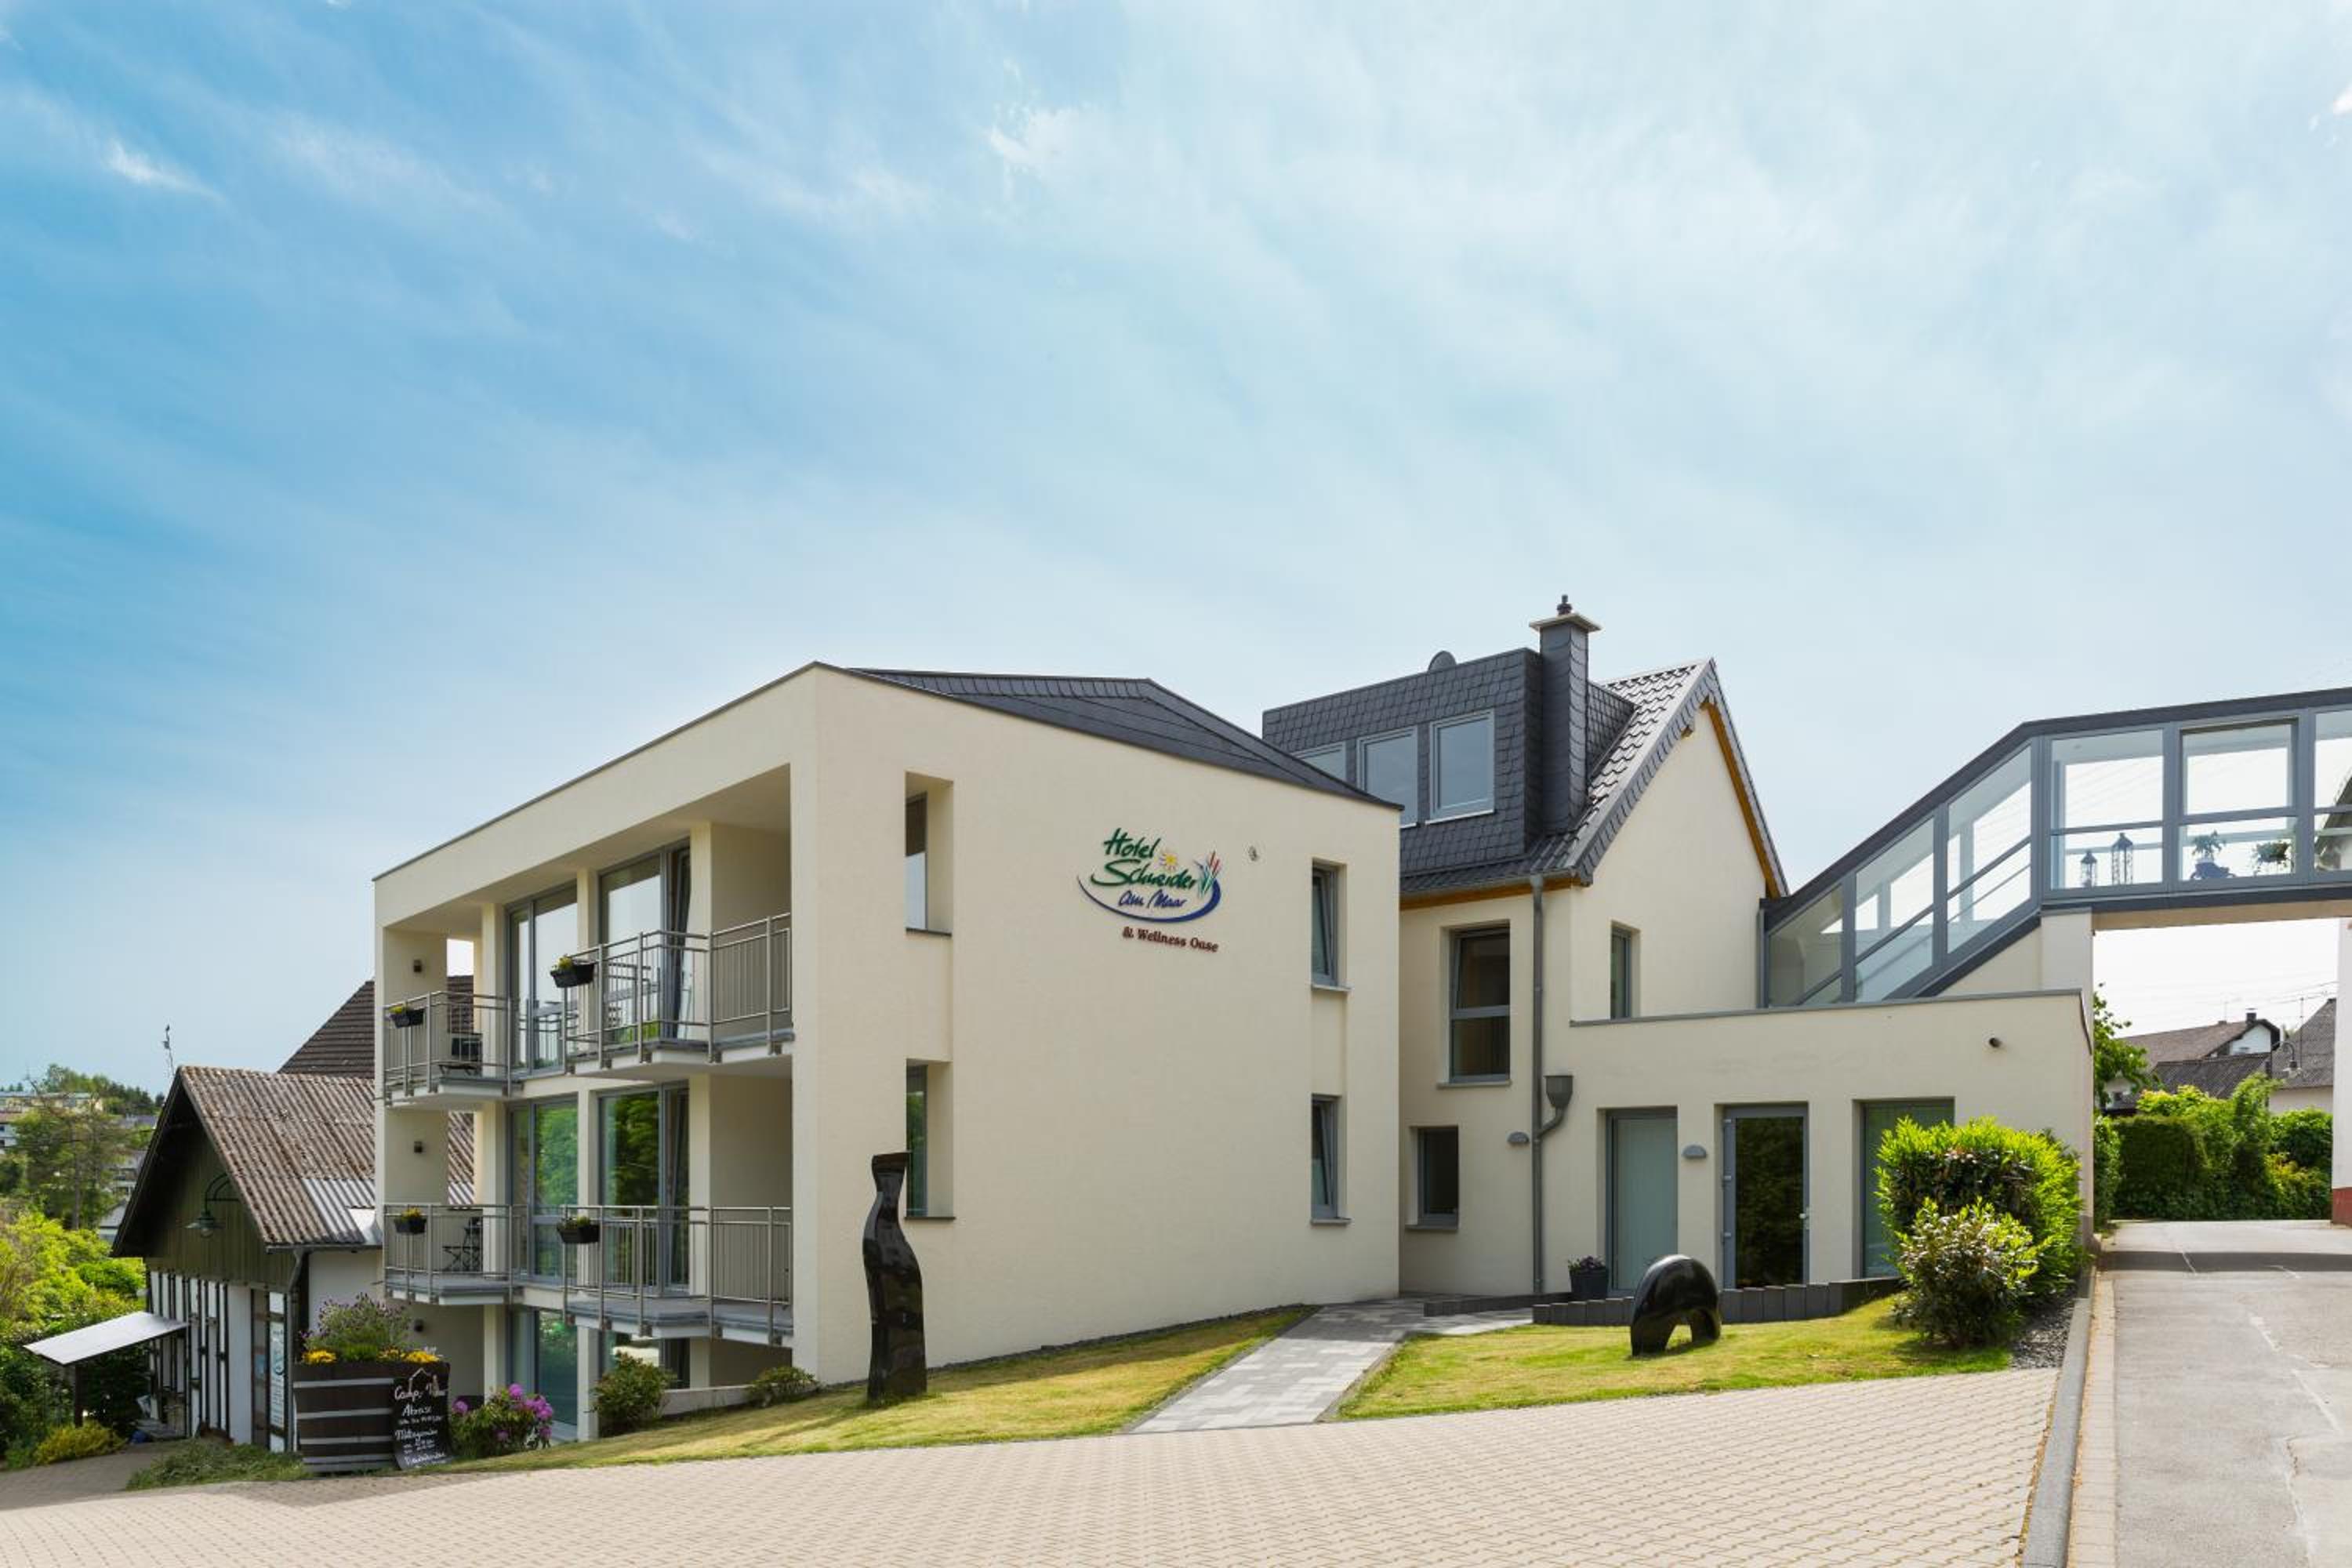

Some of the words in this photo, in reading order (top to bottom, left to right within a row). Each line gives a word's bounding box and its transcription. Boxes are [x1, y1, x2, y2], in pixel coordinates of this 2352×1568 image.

[1103, 828, 1160, 858] Hotel
[1091, 859, 1196, 889] Schneider
[1122, 927, 1134, 939] &
[1138, 928, 1186, 947] Wellness
